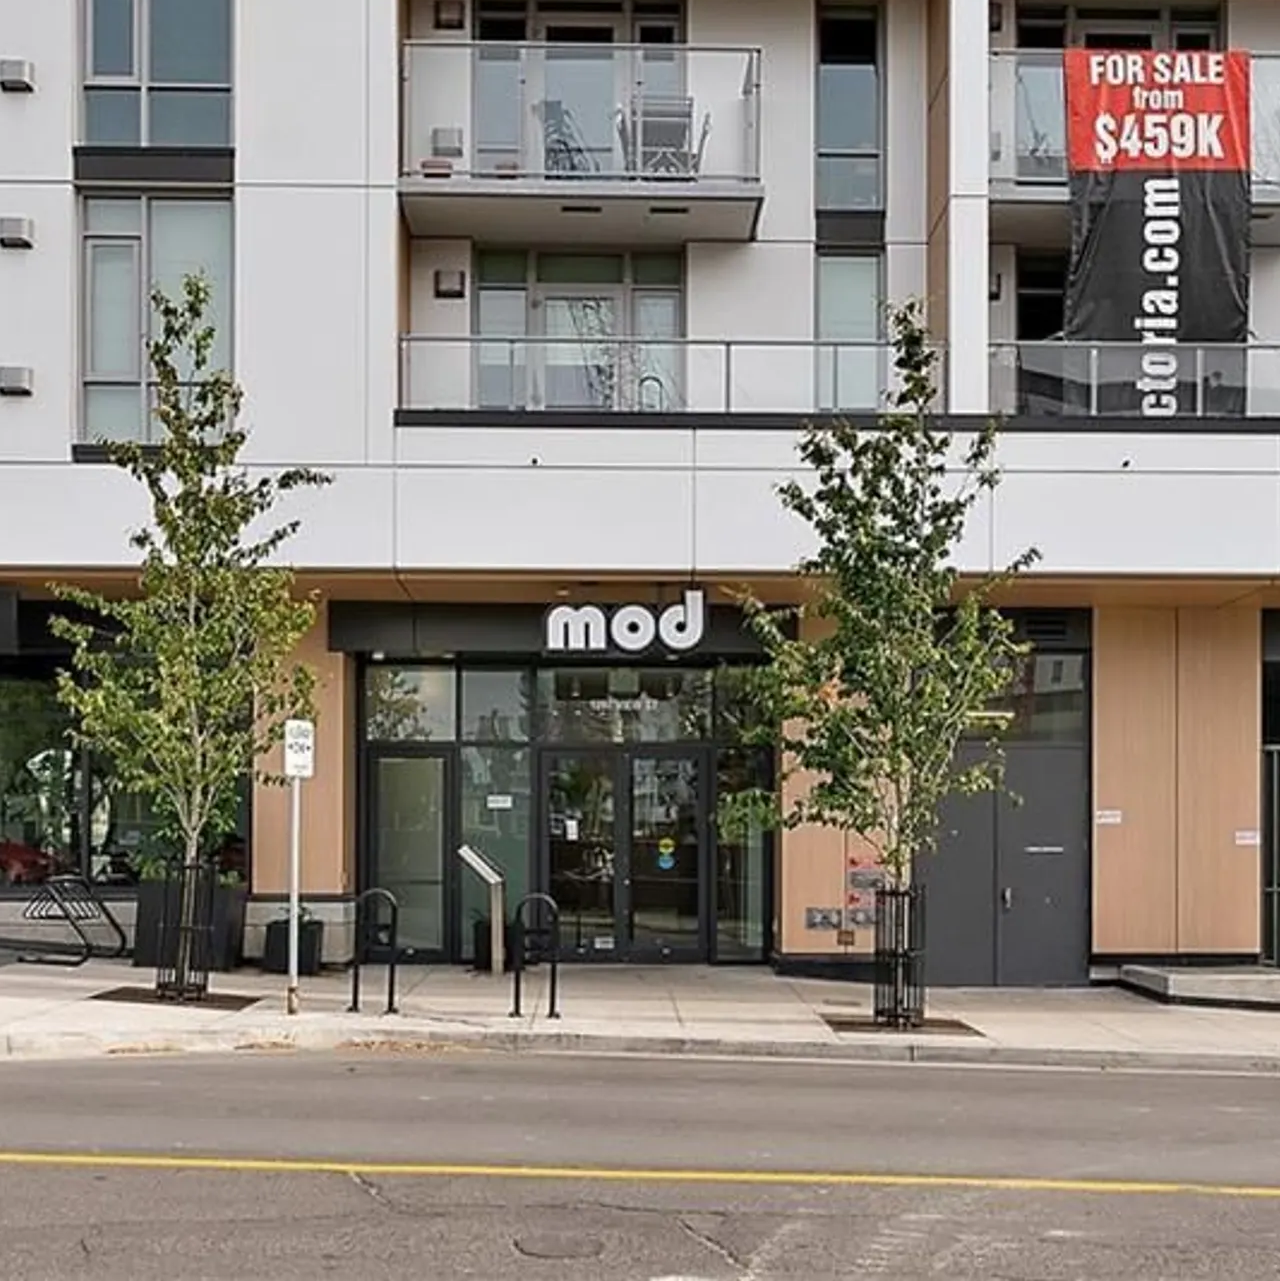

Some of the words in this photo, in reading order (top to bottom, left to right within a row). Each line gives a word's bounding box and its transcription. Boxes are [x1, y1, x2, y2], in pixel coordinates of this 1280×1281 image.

[1090, 54, 1145, 85] FOR
[1153, 53, 1225, 85] SALE
[1133, 86, 1184, 109] from
[1095, 110, 1225, 164] $459K
[547, 590, 704, 650] mod
